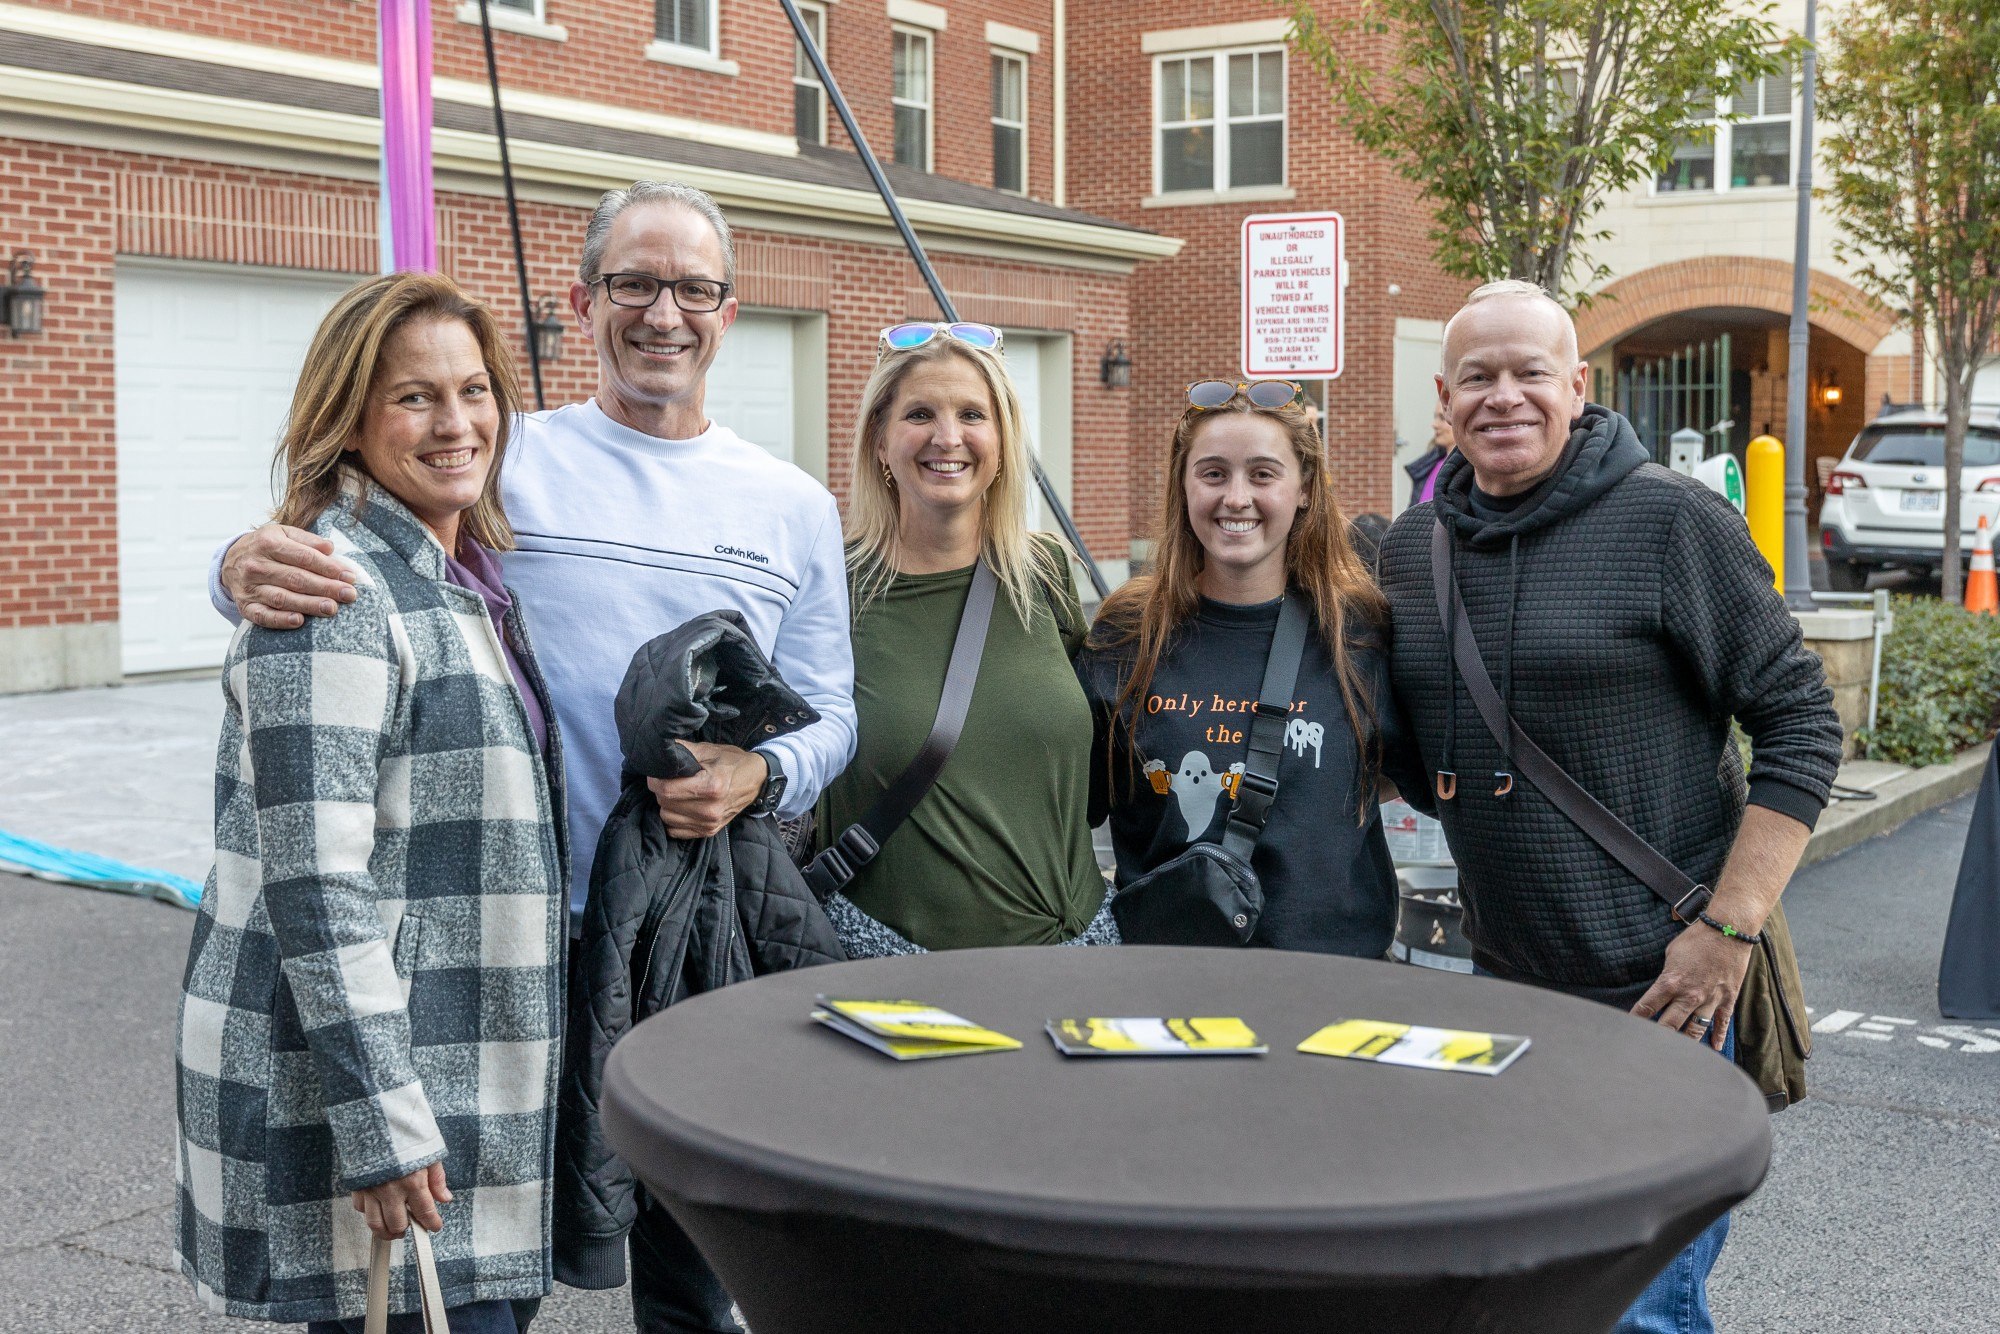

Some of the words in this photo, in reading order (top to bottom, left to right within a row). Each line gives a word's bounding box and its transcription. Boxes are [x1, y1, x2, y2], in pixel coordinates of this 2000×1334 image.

[1260, 230, 1324, 241] UNAUTHORIZED
[1286, 244, 1297, 252] OR
[1271, 256, 1313, 265] ILLEGALLY
[1253, 269, 1287, 278] PARKED
[1290, 268, 1331, 276] VEHICLES
[1275, 281, 1295, 289] WILL
[1271, 294, 1300, 302] TOWED
[1304, 293, 1313, 301] AT
[1255, 306, 1289, 314] VEHICLE
[1293, 305, 1329, 313] OWNERS
[714, 545, 745, 558] Calvin
[747, 551, 768, 564] Klein
[1147, 694, 1204, 718] Only
[1206, 725, 1243, 744] the
